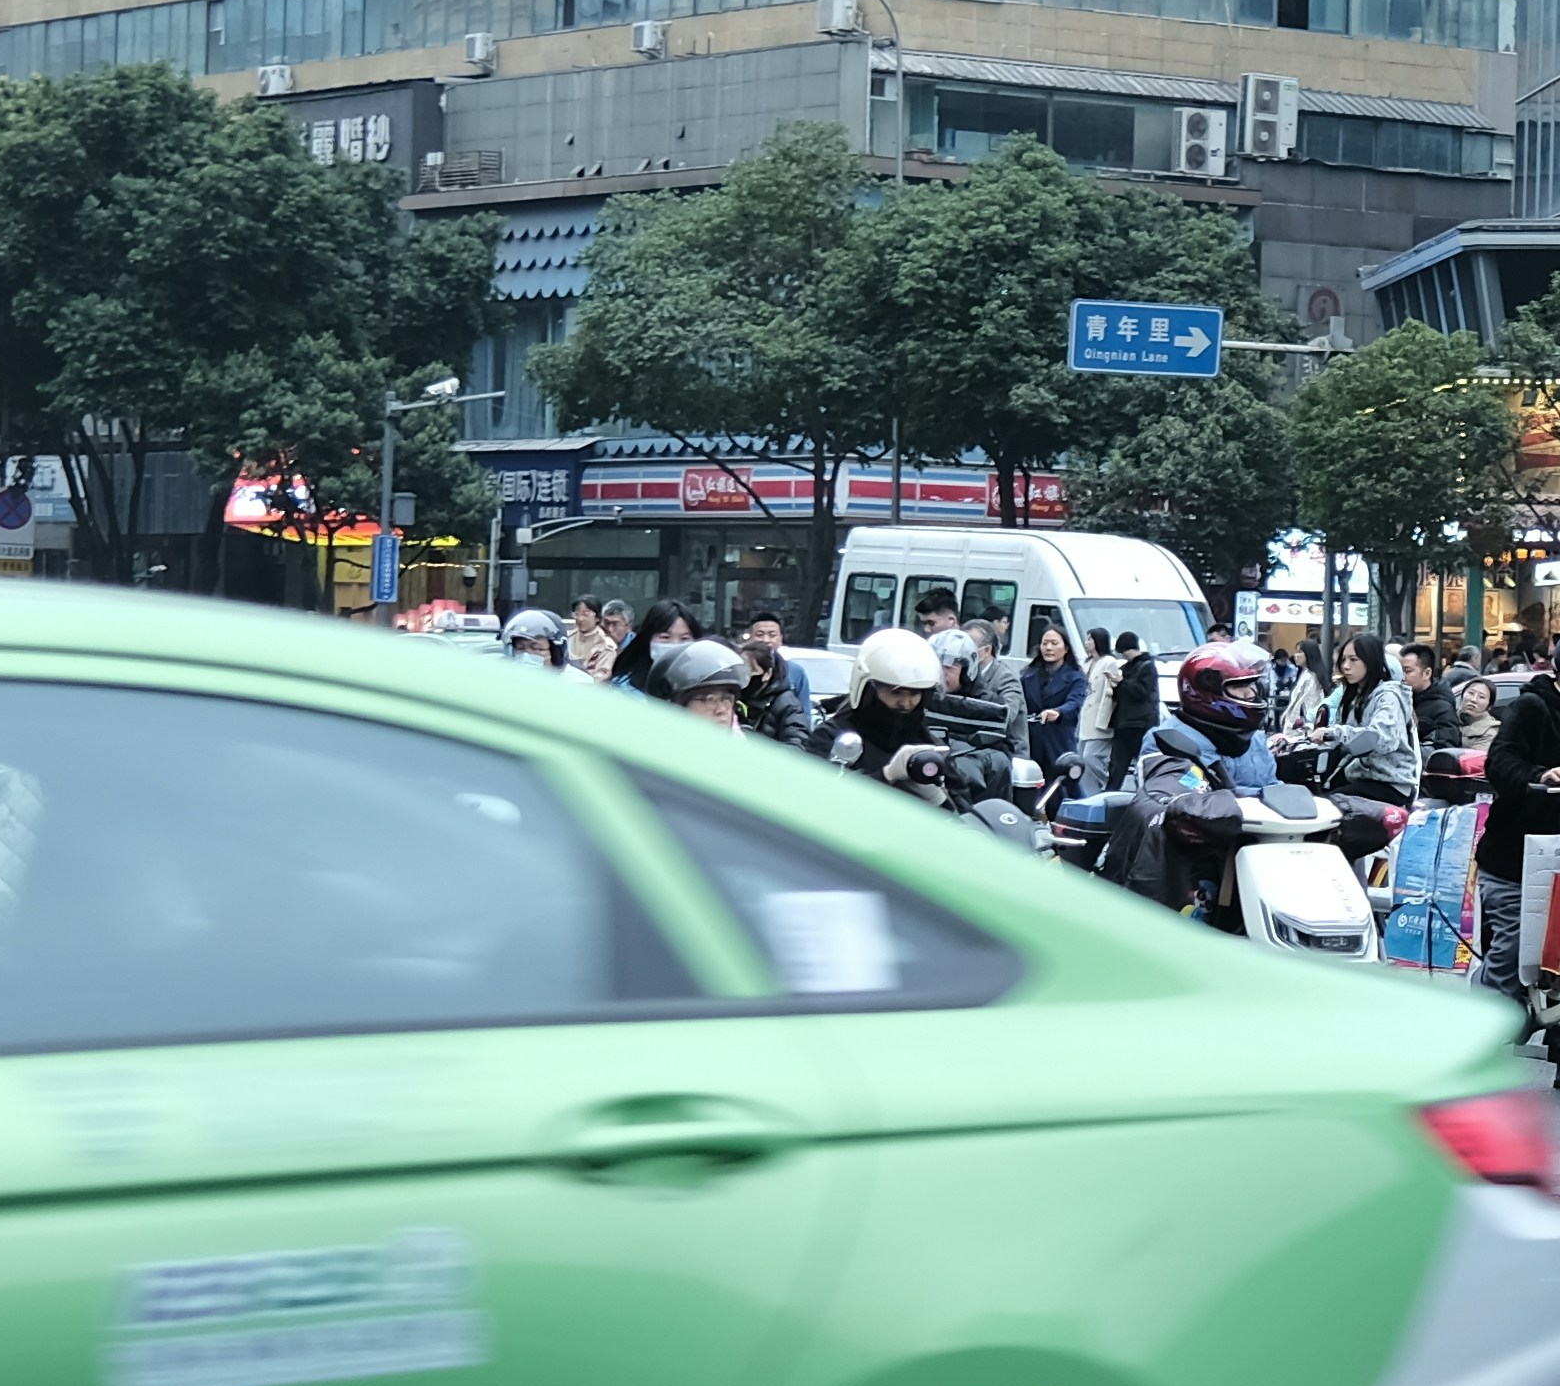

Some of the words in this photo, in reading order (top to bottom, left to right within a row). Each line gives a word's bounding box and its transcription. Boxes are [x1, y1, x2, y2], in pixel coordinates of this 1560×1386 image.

[1086, 315, 1170, 342] 青年里
[1084, 348, 1137, 363] Qingnian
[1141, 351, 1169, 363] Lane
